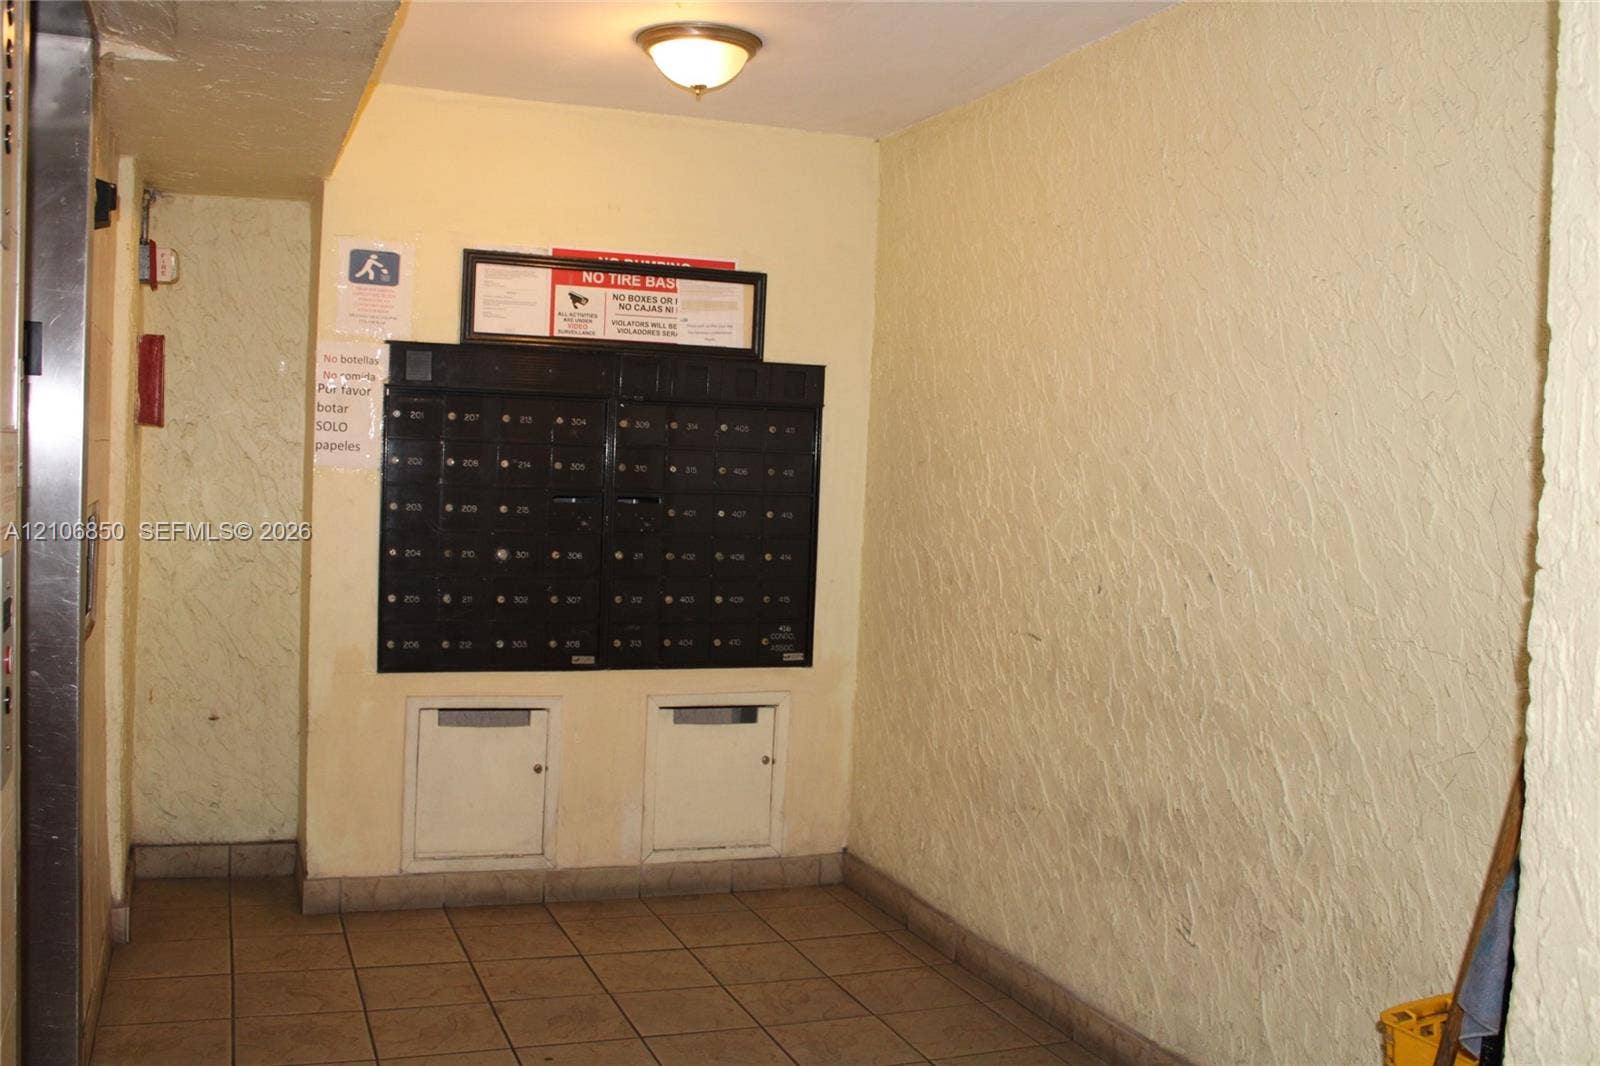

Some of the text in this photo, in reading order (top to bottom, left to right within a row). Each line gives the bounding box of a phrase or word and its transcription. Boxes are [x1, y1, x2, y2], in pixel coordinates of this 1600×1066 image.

[582, 271, 604, 284] NO
[608, 273, 641, 287] TIRE
[612, 293, 626, 302] NO
[627, 295, 658, 304] BOXES
[660, 297, 673, 305] OR
[618, 302, 632, 311] NO
[633, 303, 663, 313] CAJAS
[567, 322, 588, 330] VIDEO
[611, 319, 650, 328] VIOLATORS
[616, 328, 661, 337] VIOLADORES
[323, 354, 380, 366] No botellas
[322, 370, 338, 381] No
[317, 383, 372, 397] Por favor
[316, 402, 349, 414] botar
[409, 410, 425, 420] 201
[463, 412, 480, 422] 207
[519, 415, 534, 424] 213
[315, 420, 348, 433] SOLO
[570, 417, 587, 427] 304
[634, 420, 651, 430] 309
[685, 422, 699, 431] 314
[314, 441, 361, 453] papeles
[407, 456, 424, 466] 202
[462, 458, 480, 468] 208
[516, 459, 532, 470] 214
[633, 464, 648, 473] 310
[684, 465, 698, 474] 315
[405, 502, 423, 512] 203
[460, 504, 478, 513] 209
[516, 505, 530, 514] 215
[682, 509, 697, 518] 401
[731, 510, 747, 519] 407
[404, 548, 422, 558] 204
[461, 549, 476, 559] 210
[515, 550, 529, 560] 301
[567, 551, 583, 560] 306
[680, 552, 696, 561] 402
[512, 595, 529, 605] 302
[565, 595, 582, 605] 307
[728, 595, 745, 604] 409
[402, 640, 420, 650] 206
[458, 640, 473, 650] 212
[511, 639, 528, 649] 303
[564, 640, 581, 649] 308
[677, 638, 694, 647] 404
[728, 638, 742, 647] 410
